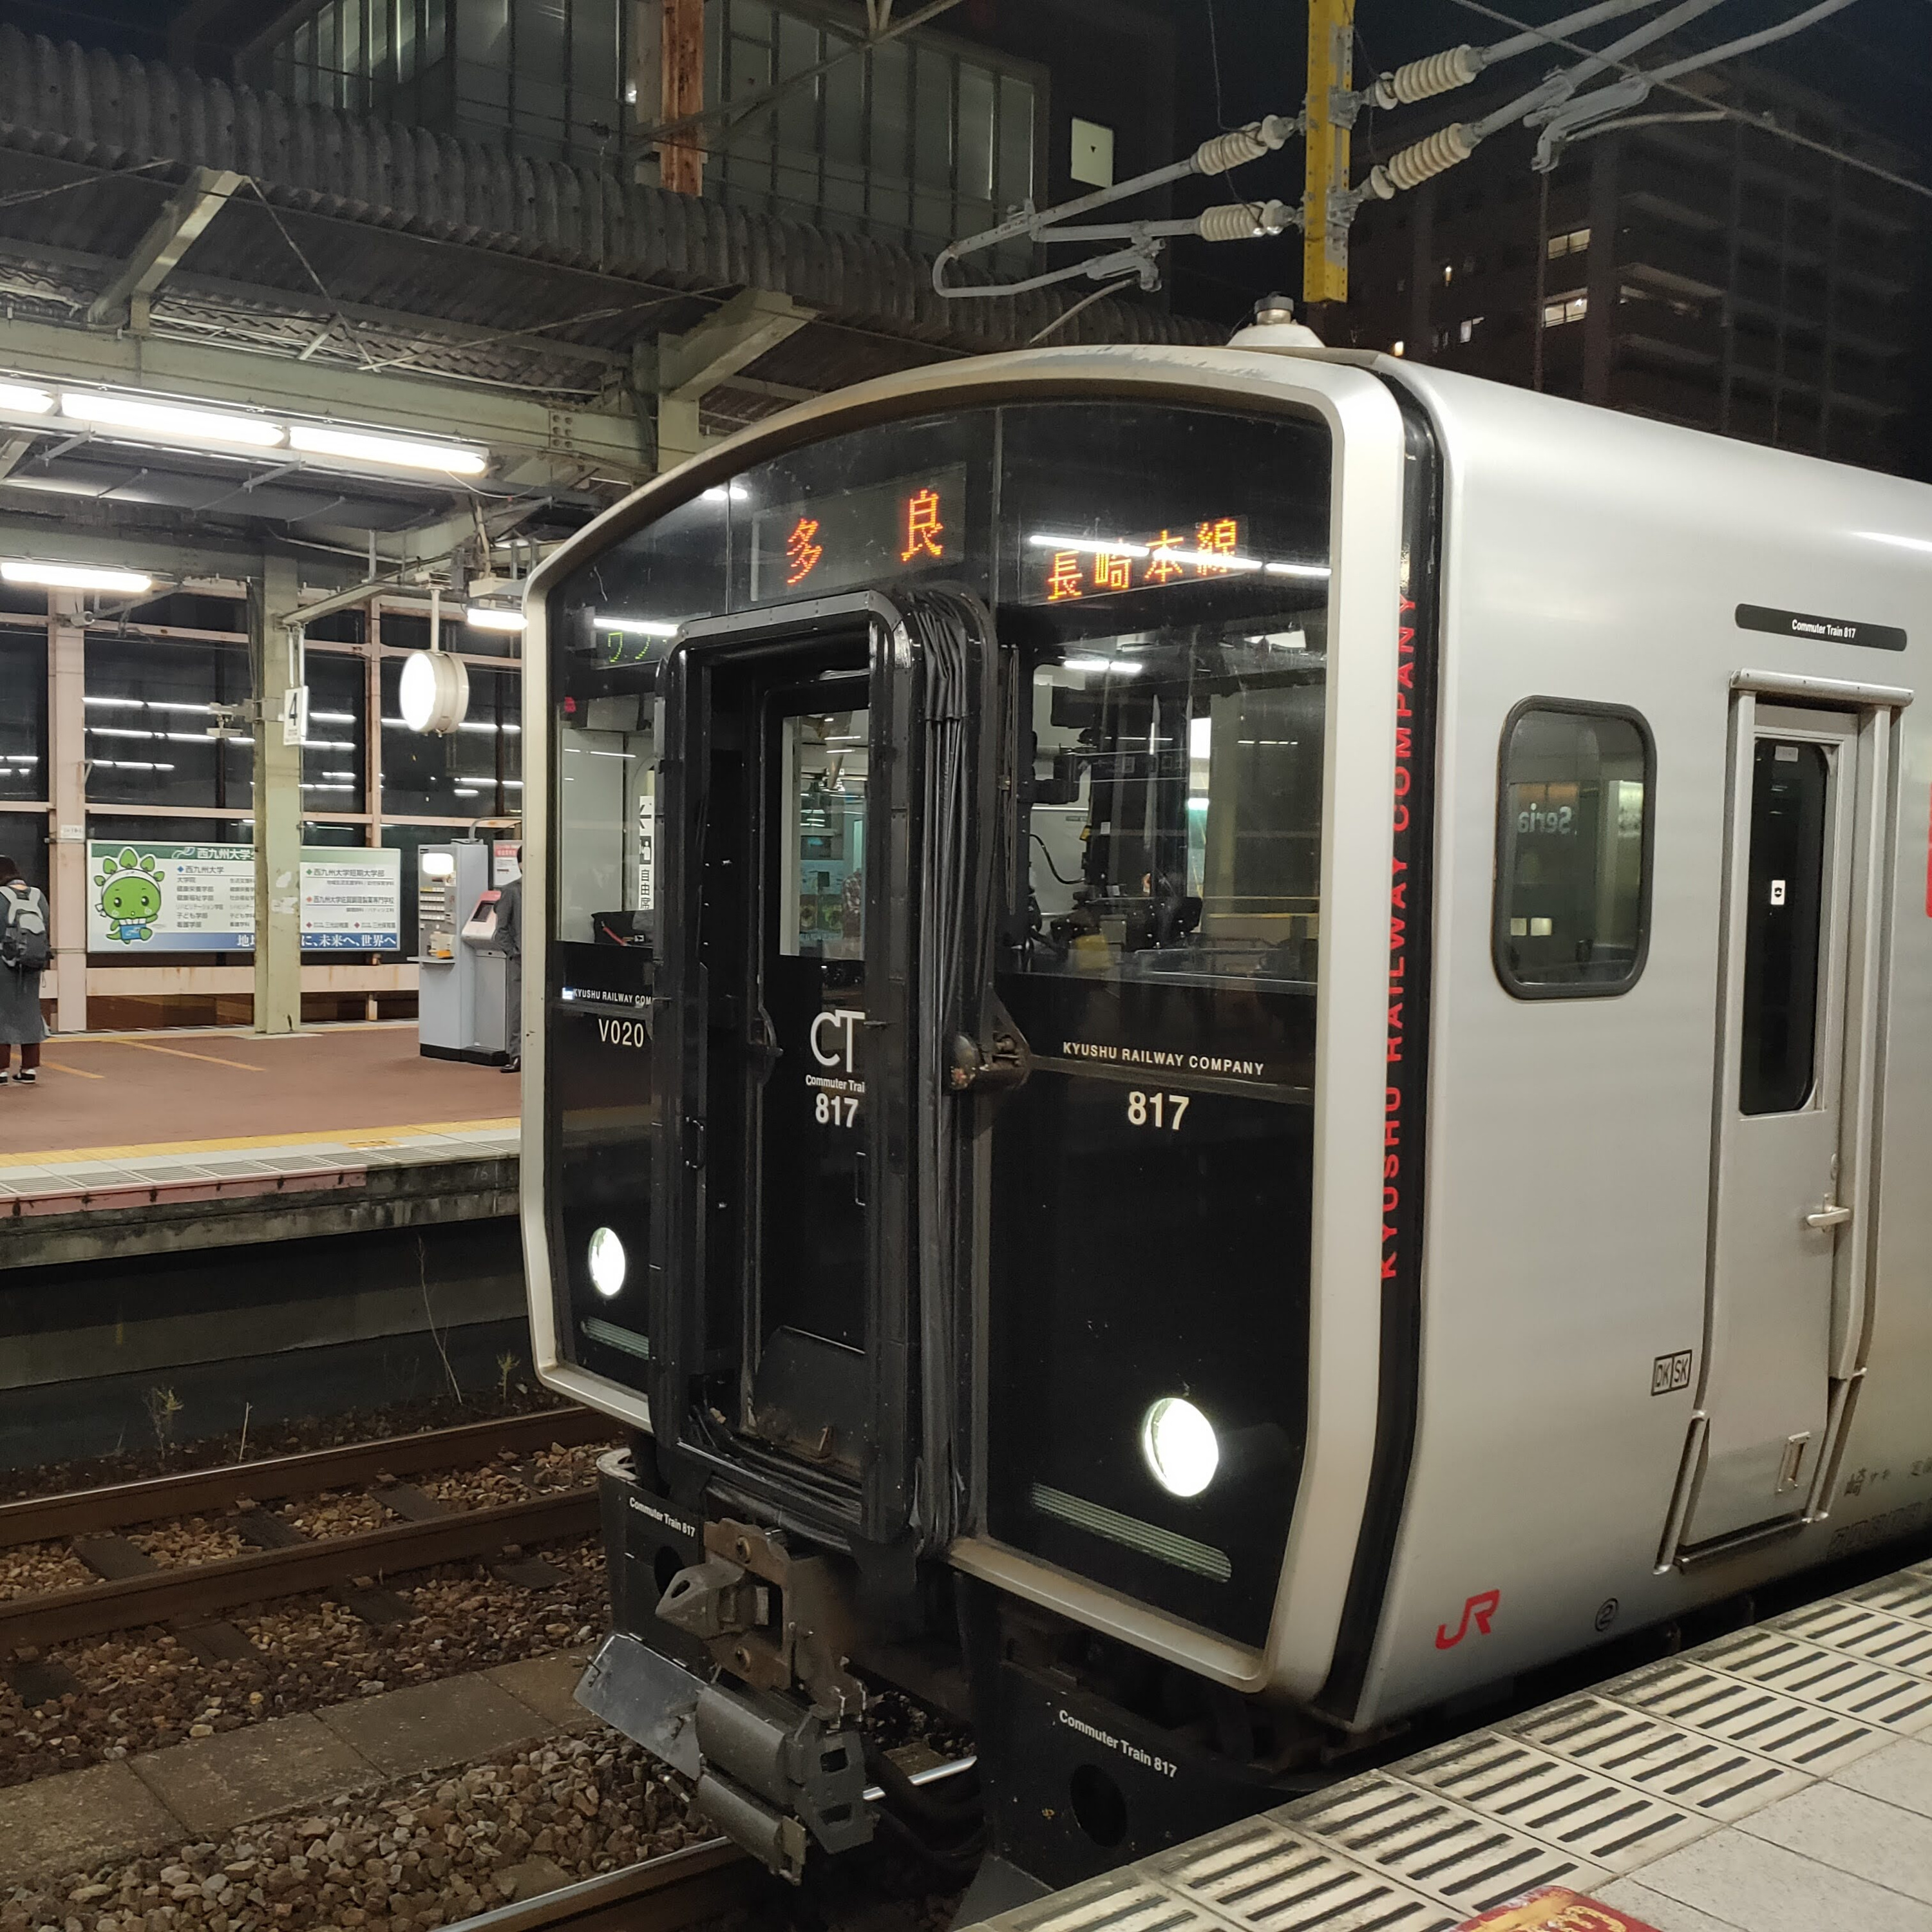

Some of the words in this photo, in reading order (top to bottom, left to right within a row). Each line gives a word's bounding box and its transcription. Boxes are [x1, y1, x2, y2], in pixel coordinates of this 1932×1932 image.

[786, 488, 944, 585] 多良
[1046, 518, 1237, 601] 長崎本線
[1792, 619, 1826, 634] Commuter
[1826, 625, 1842, 637] Train
[1844, 627, 1856, 638] 817
[289, 692, 298, 726] 4
[1392, 594, 1416, 832] COMPANY
[185, 866, 224, 874] 西九州大学
[196, 848, 255, 860] 西九州大学
[1386, 857, 1408, 1063] RAILWAY
[573, 988, 600, 999] KYUSHU
[602, 991, 632, 1003] RAILWAY
[634, 995, 652, 1005] COM
[598, 1019, 644, 1048] V020
[810, 1009, 866, 1073] CT
[1063, 1041, 1117, 1059] KYUSHU
[1122, 1048, 1184, 1067] RAILWAY
[1189, 1056, 1264, 1075] COMPANY
[806, 1074, 848, 1090] Commuter
[848, 1079, 866, 1093] Trai
[815, 1093, 859, 1128] 817
[1128, 1091, 1189, 1130] 817
[1380, 1086, 1401, 1280] KYUSHU
[1674, 1358, 1688, 1383] SK
[629, 1497, 663, 1521] Commuter
[663, 1513, 681, 1531] Train
[682, 1522, 696, 1537] 817
[1435, 1589, 1501, 1650] JR
[1059, 1709, 1119, 1748] Commuter
[1121, 1739, 1151, 1766] Train
[1153, 1757, 1177, 1777] 817
